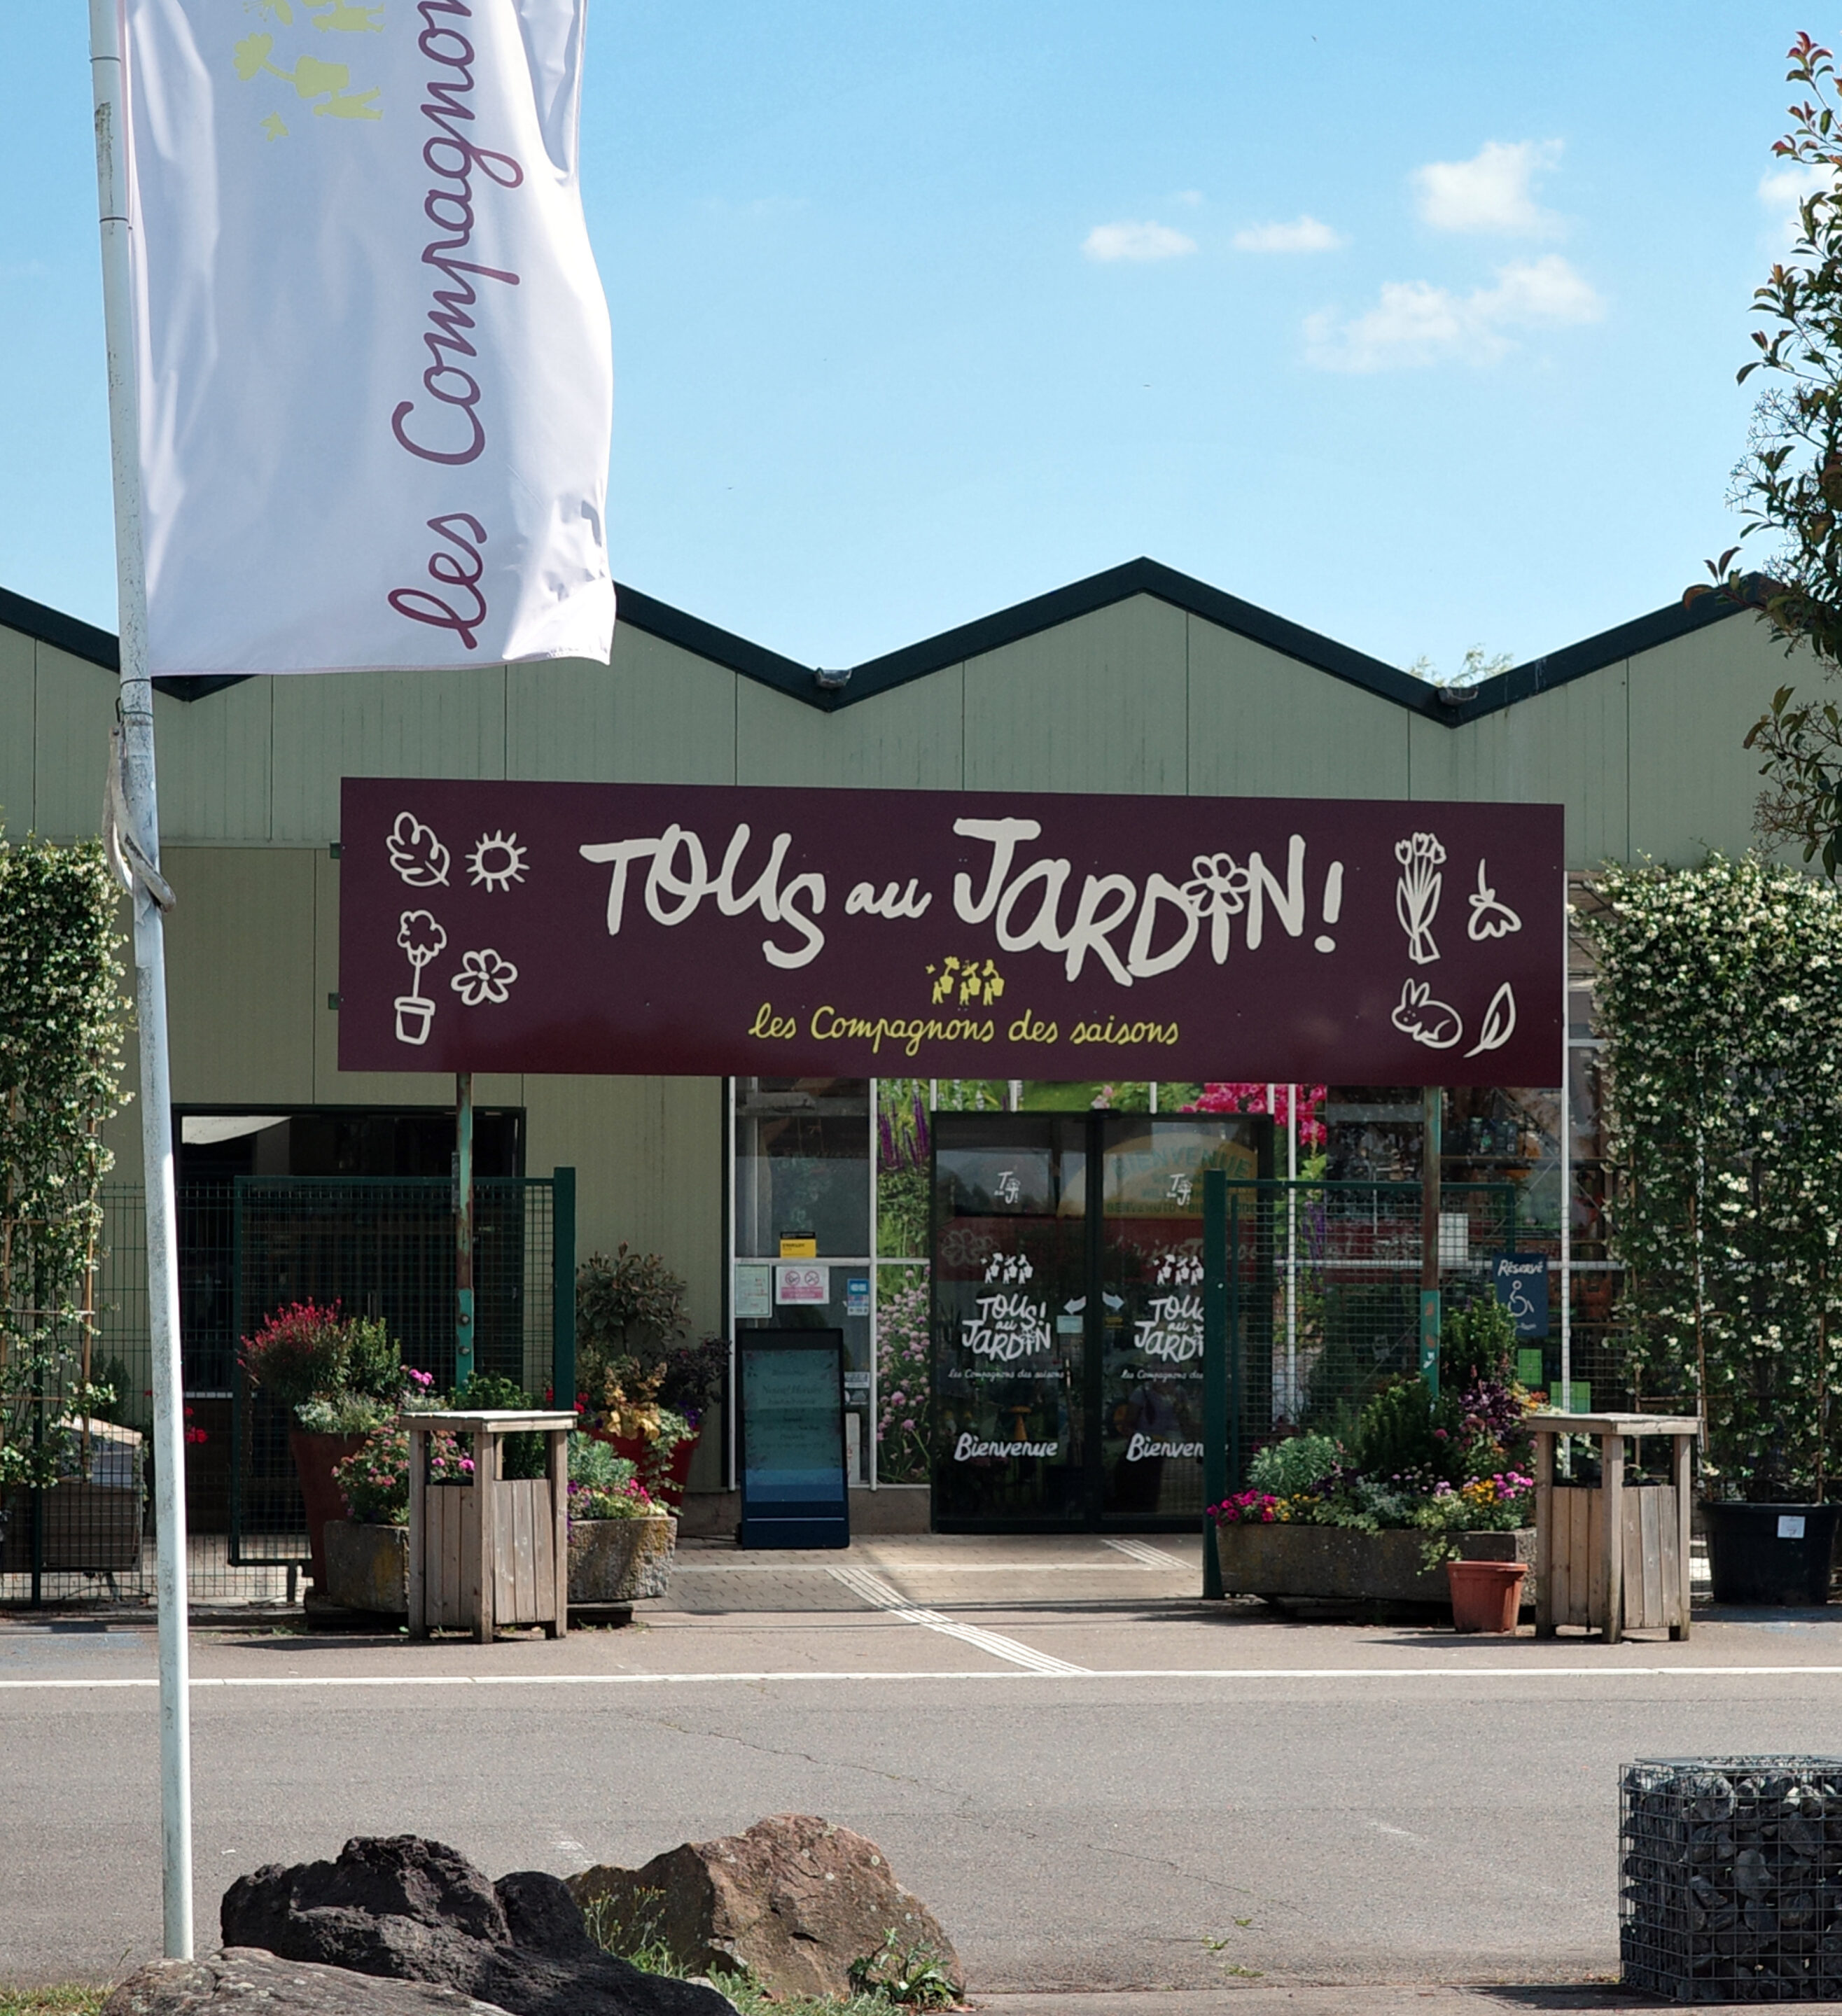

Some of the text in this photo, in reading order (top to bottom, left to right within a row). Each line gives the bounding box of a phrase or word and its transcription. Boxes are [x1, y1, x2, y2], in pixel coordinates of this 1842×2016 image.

[386, 512, 488, 651] les
[578, 822, 827, 969] TOUS
[844, 878, 933, 920] au
[748, 1002, 1179, 1056] les Compagnons des saisons
[962, 1320, 1051, 1362] JARDIN
[995, 1320, 1017, 1331] au
[1134, 1321, 1204, 1363] JARDI
[1167, 1321, 1189, 1331] au
[954, 1432, 1059, 1461] Bienvenue
[1126, 1433, 1204, 1461] Bienven
